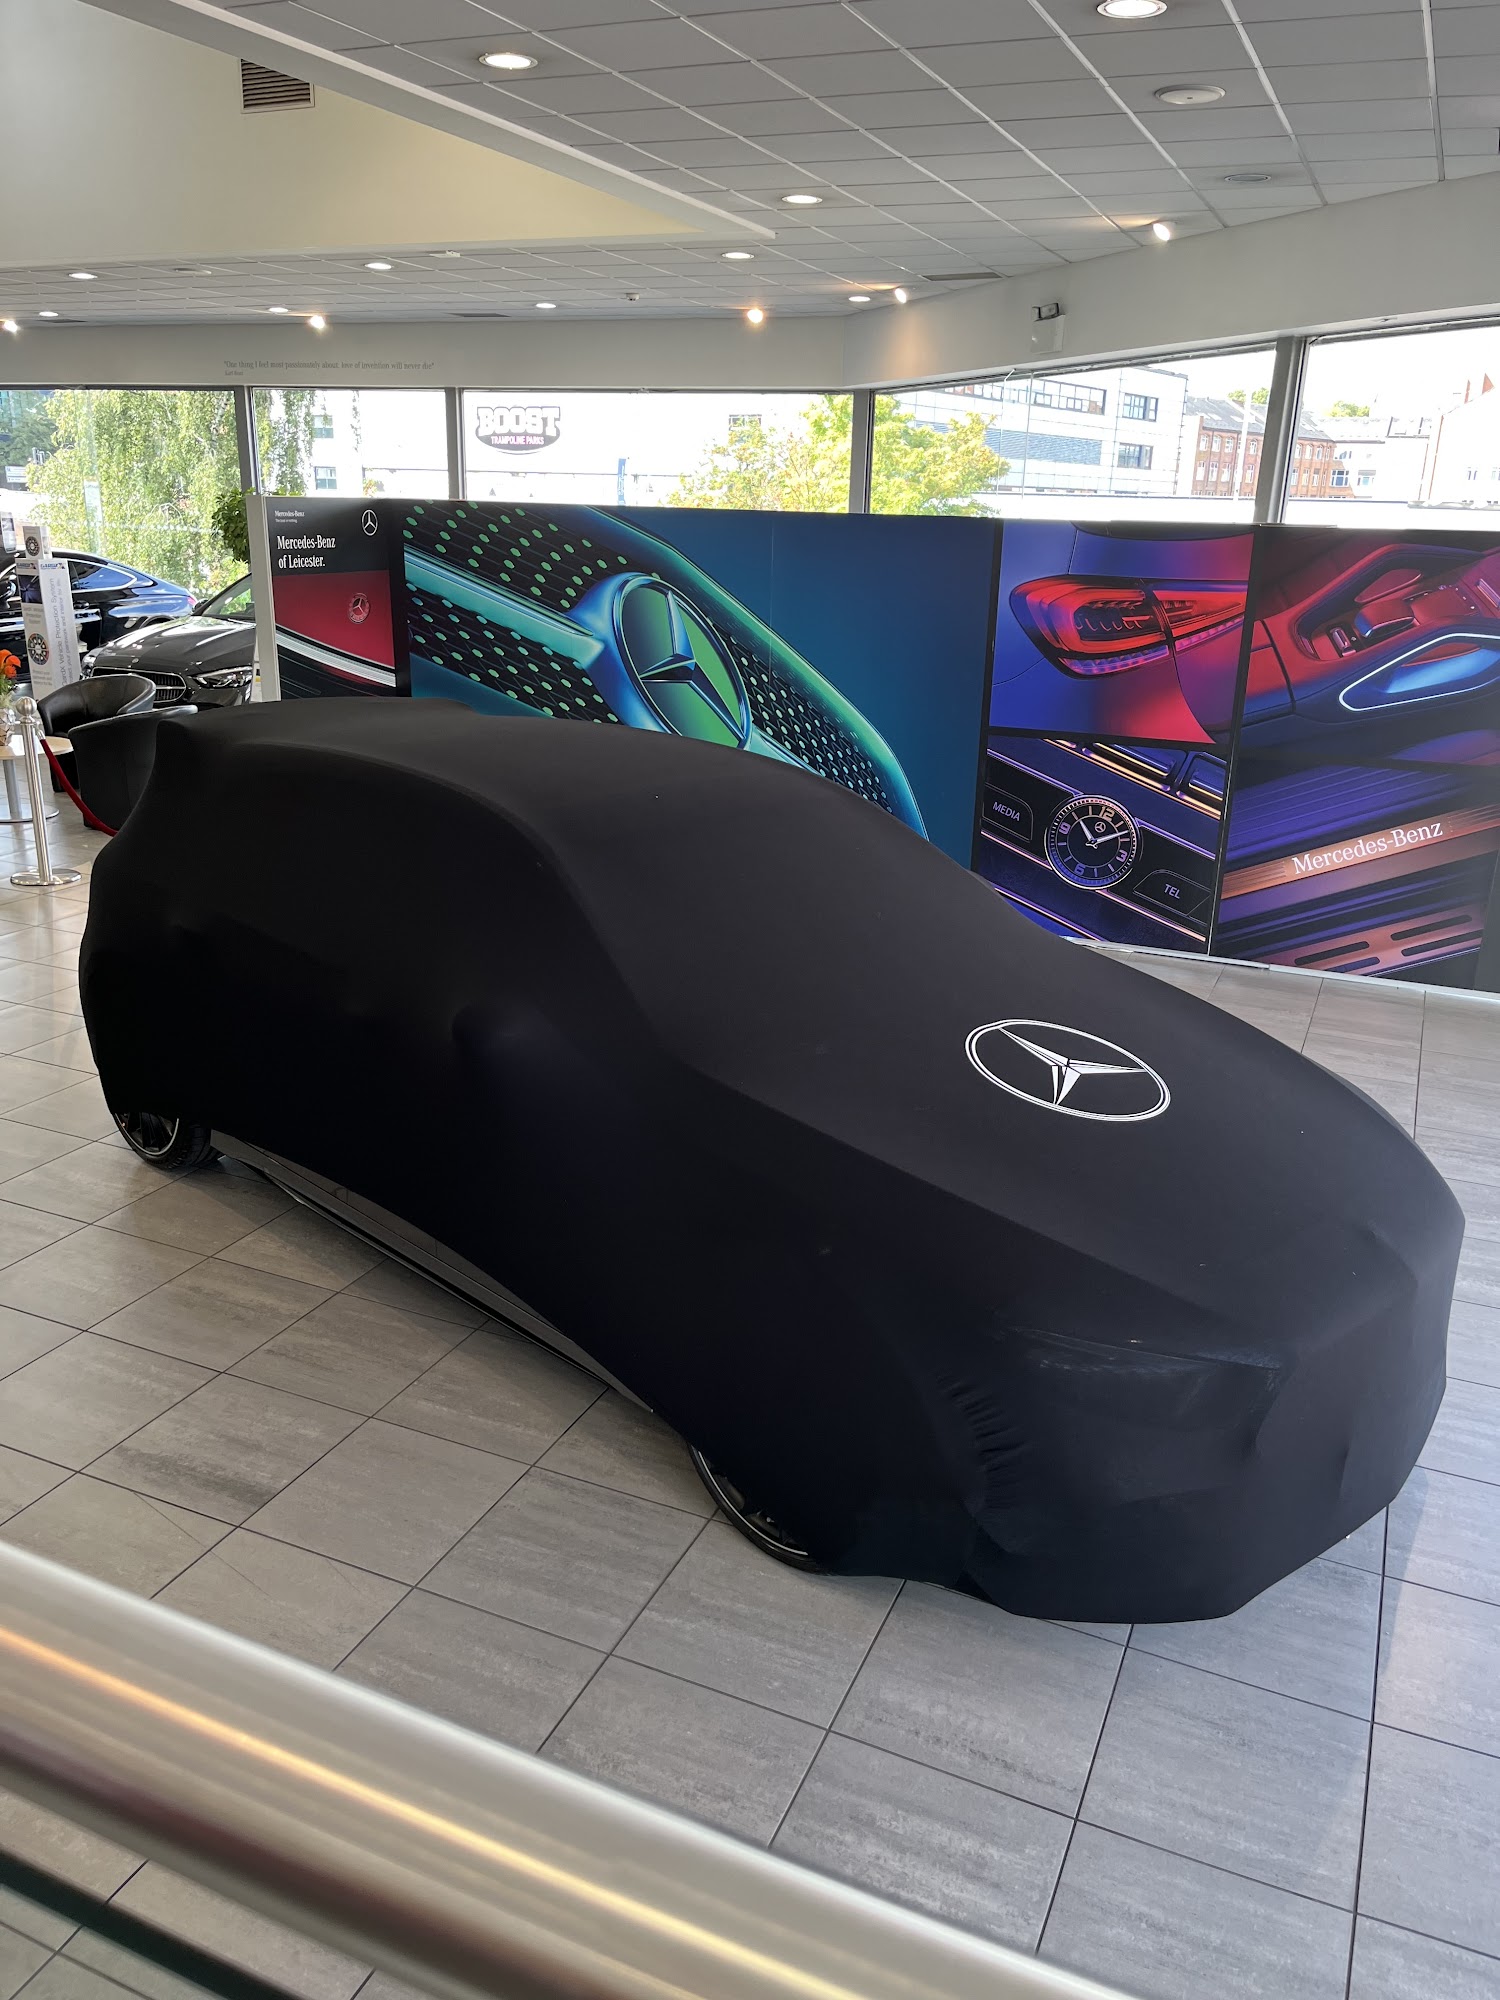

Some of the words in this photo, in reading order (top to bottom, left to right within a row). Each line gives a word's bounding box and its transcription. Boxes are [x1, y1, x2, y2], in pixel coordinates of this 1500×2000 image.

[239, 361, 254, 370] thing
[285, 361, 320, 370] passionately
[362, 362, 390, 370] invention
[391, 362, 402, 370] will
[477, 406, 561, 437] BOOST
[491, 435, 526, 445] TRAMPOLINE
[526, 435, 545, 445] PARKS
[277, 534, 336, 550] Mercedes-Benz
[278, 554, 287, 568] of
[288, 554, 326, 568] Leicester.
[49, 578, 58, 603] System
[52, 606, 62, 639] Protection
[993, 801, 1021, 821] MEDIA
[1099, 806, 1115, 822] 12
[1059, 823, 1070, 835] 9
[1116, 850, 1128, 862] 3
[1292, 822, 1443, 874] Mercedes-Benz
[1074, 866, 1085, 876] 6
[1164, 883, 1181, 900] TEL
